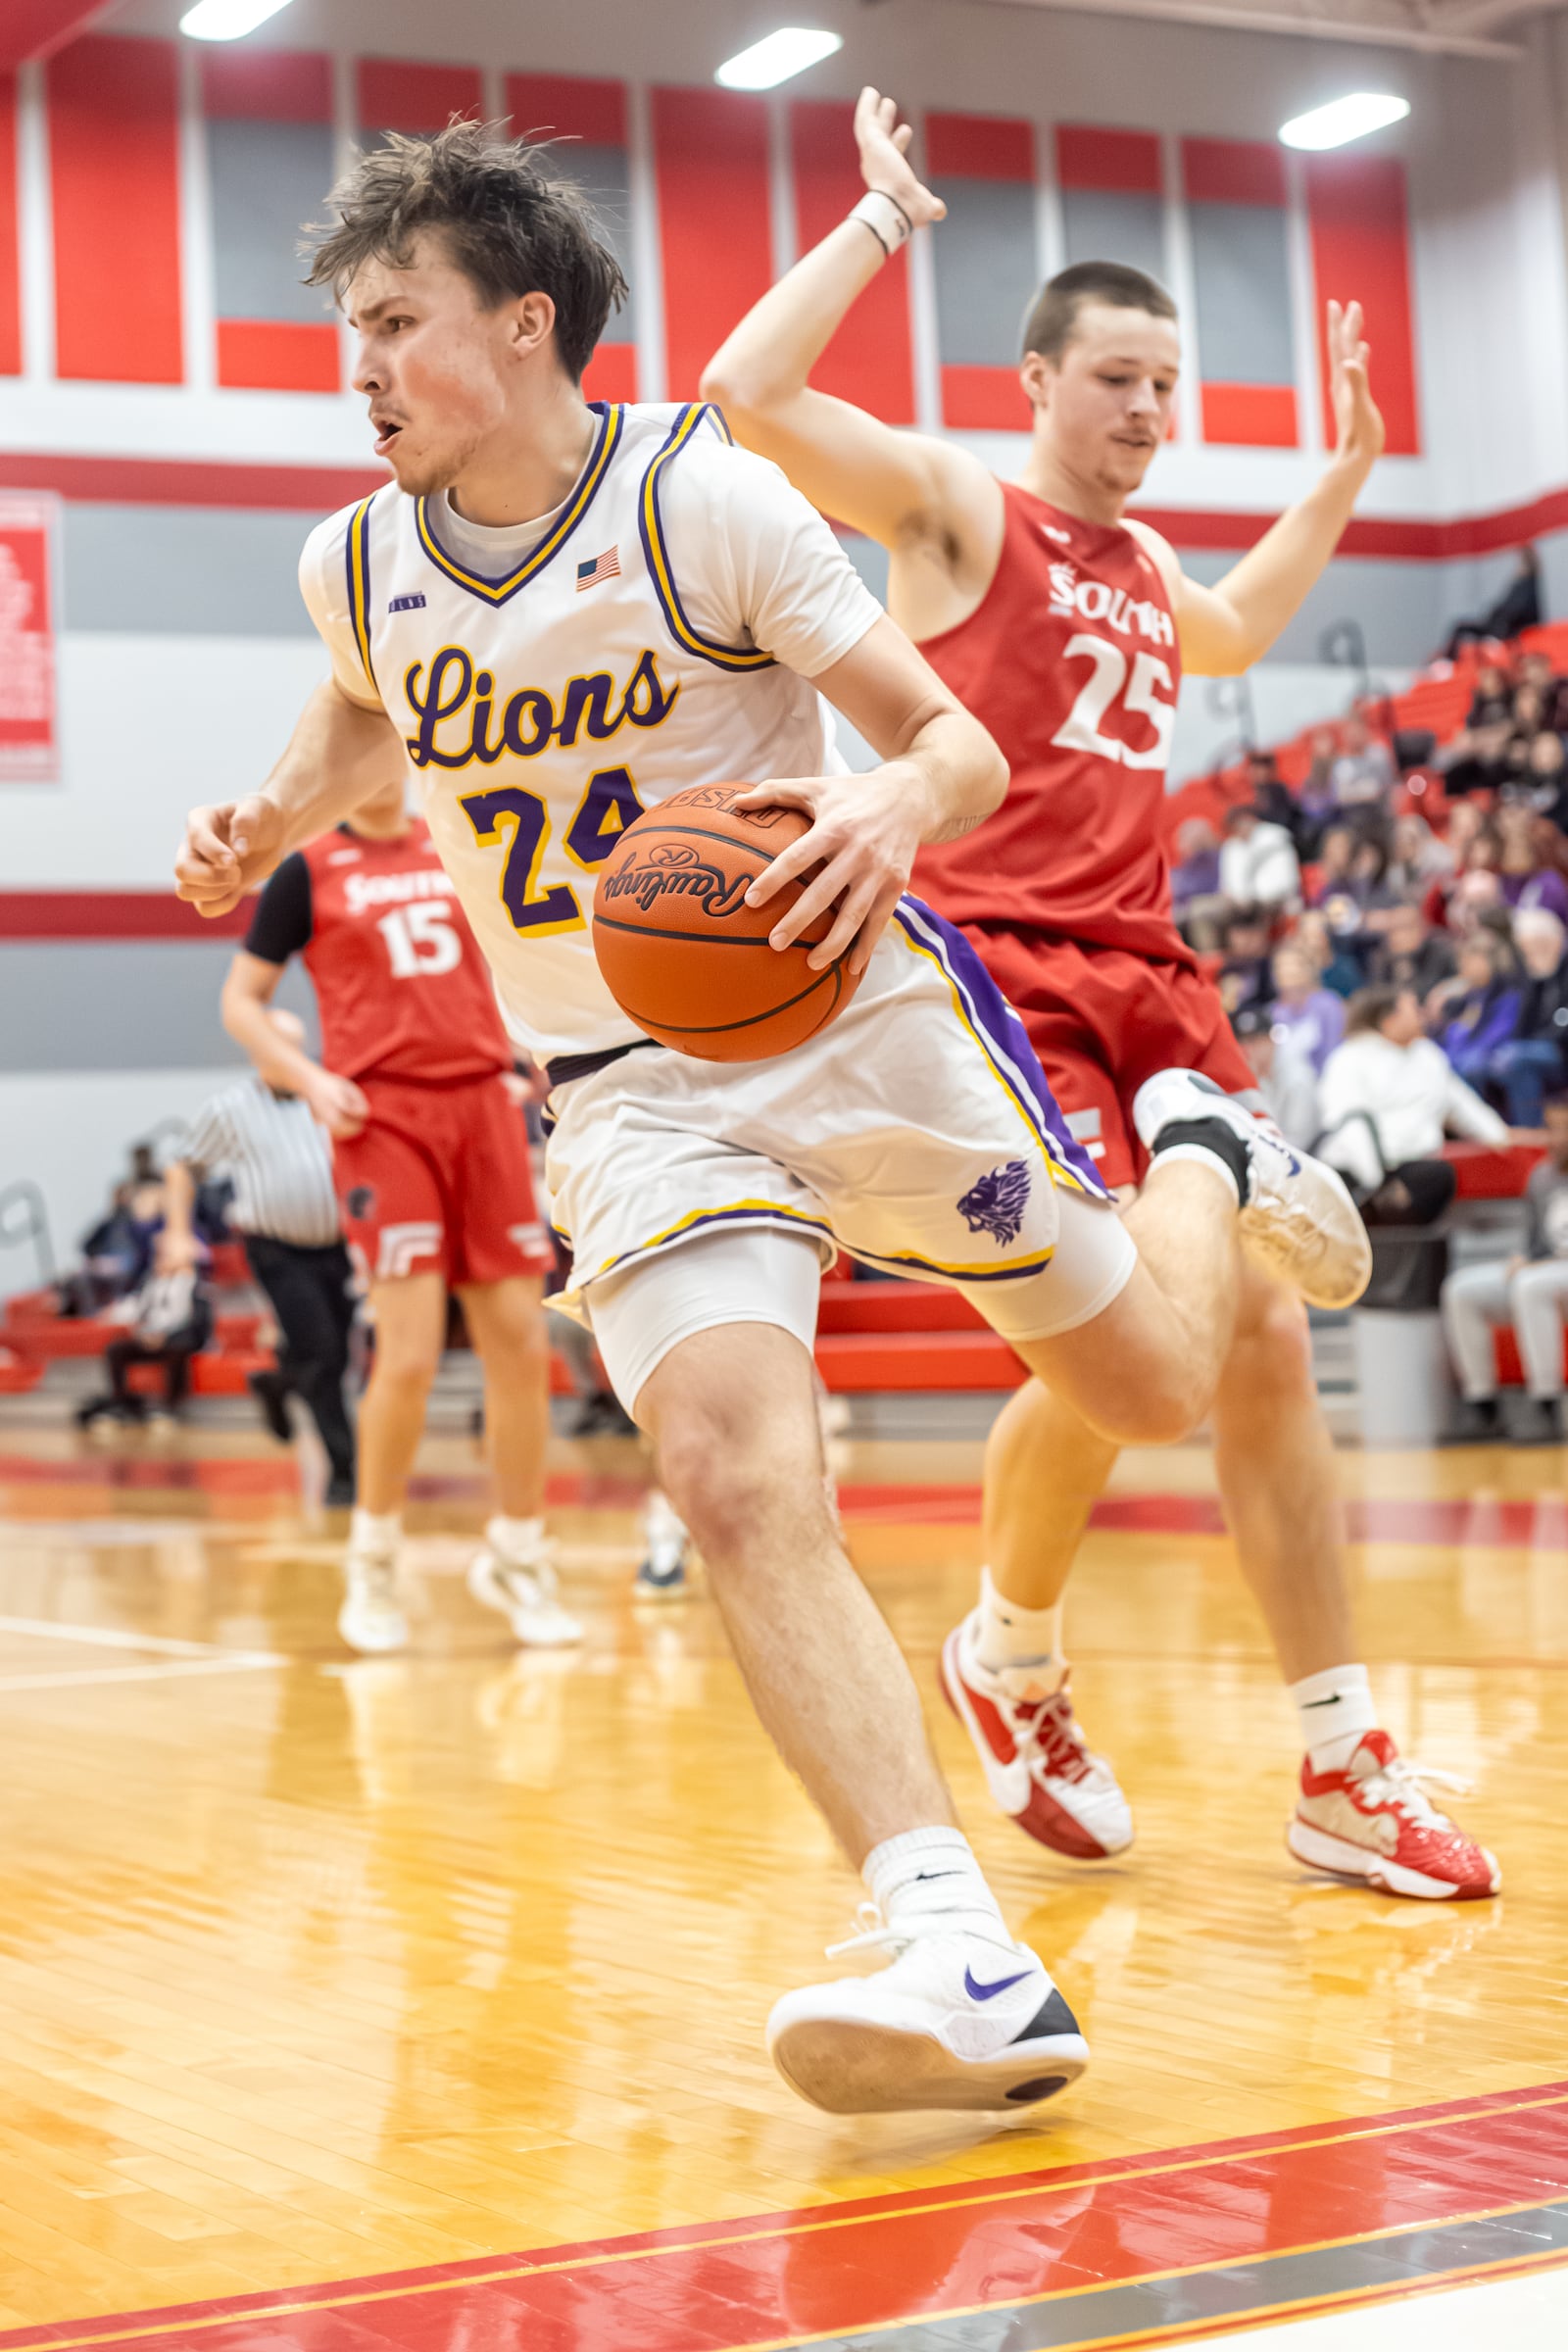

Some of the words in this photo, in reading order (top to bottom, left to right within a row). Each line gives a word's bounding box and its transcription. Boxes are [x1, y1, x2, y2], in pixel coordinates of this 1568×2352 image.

[1048, 562, 1174, 647] SOUTH
[403, 644, 681, 771] Lions
[1050, 633, 1176, 770] 25
[457, 764, 646, 939] 24
[604, 851, 756, 917] Rawlings
[376, 900, 463, 979] 15
